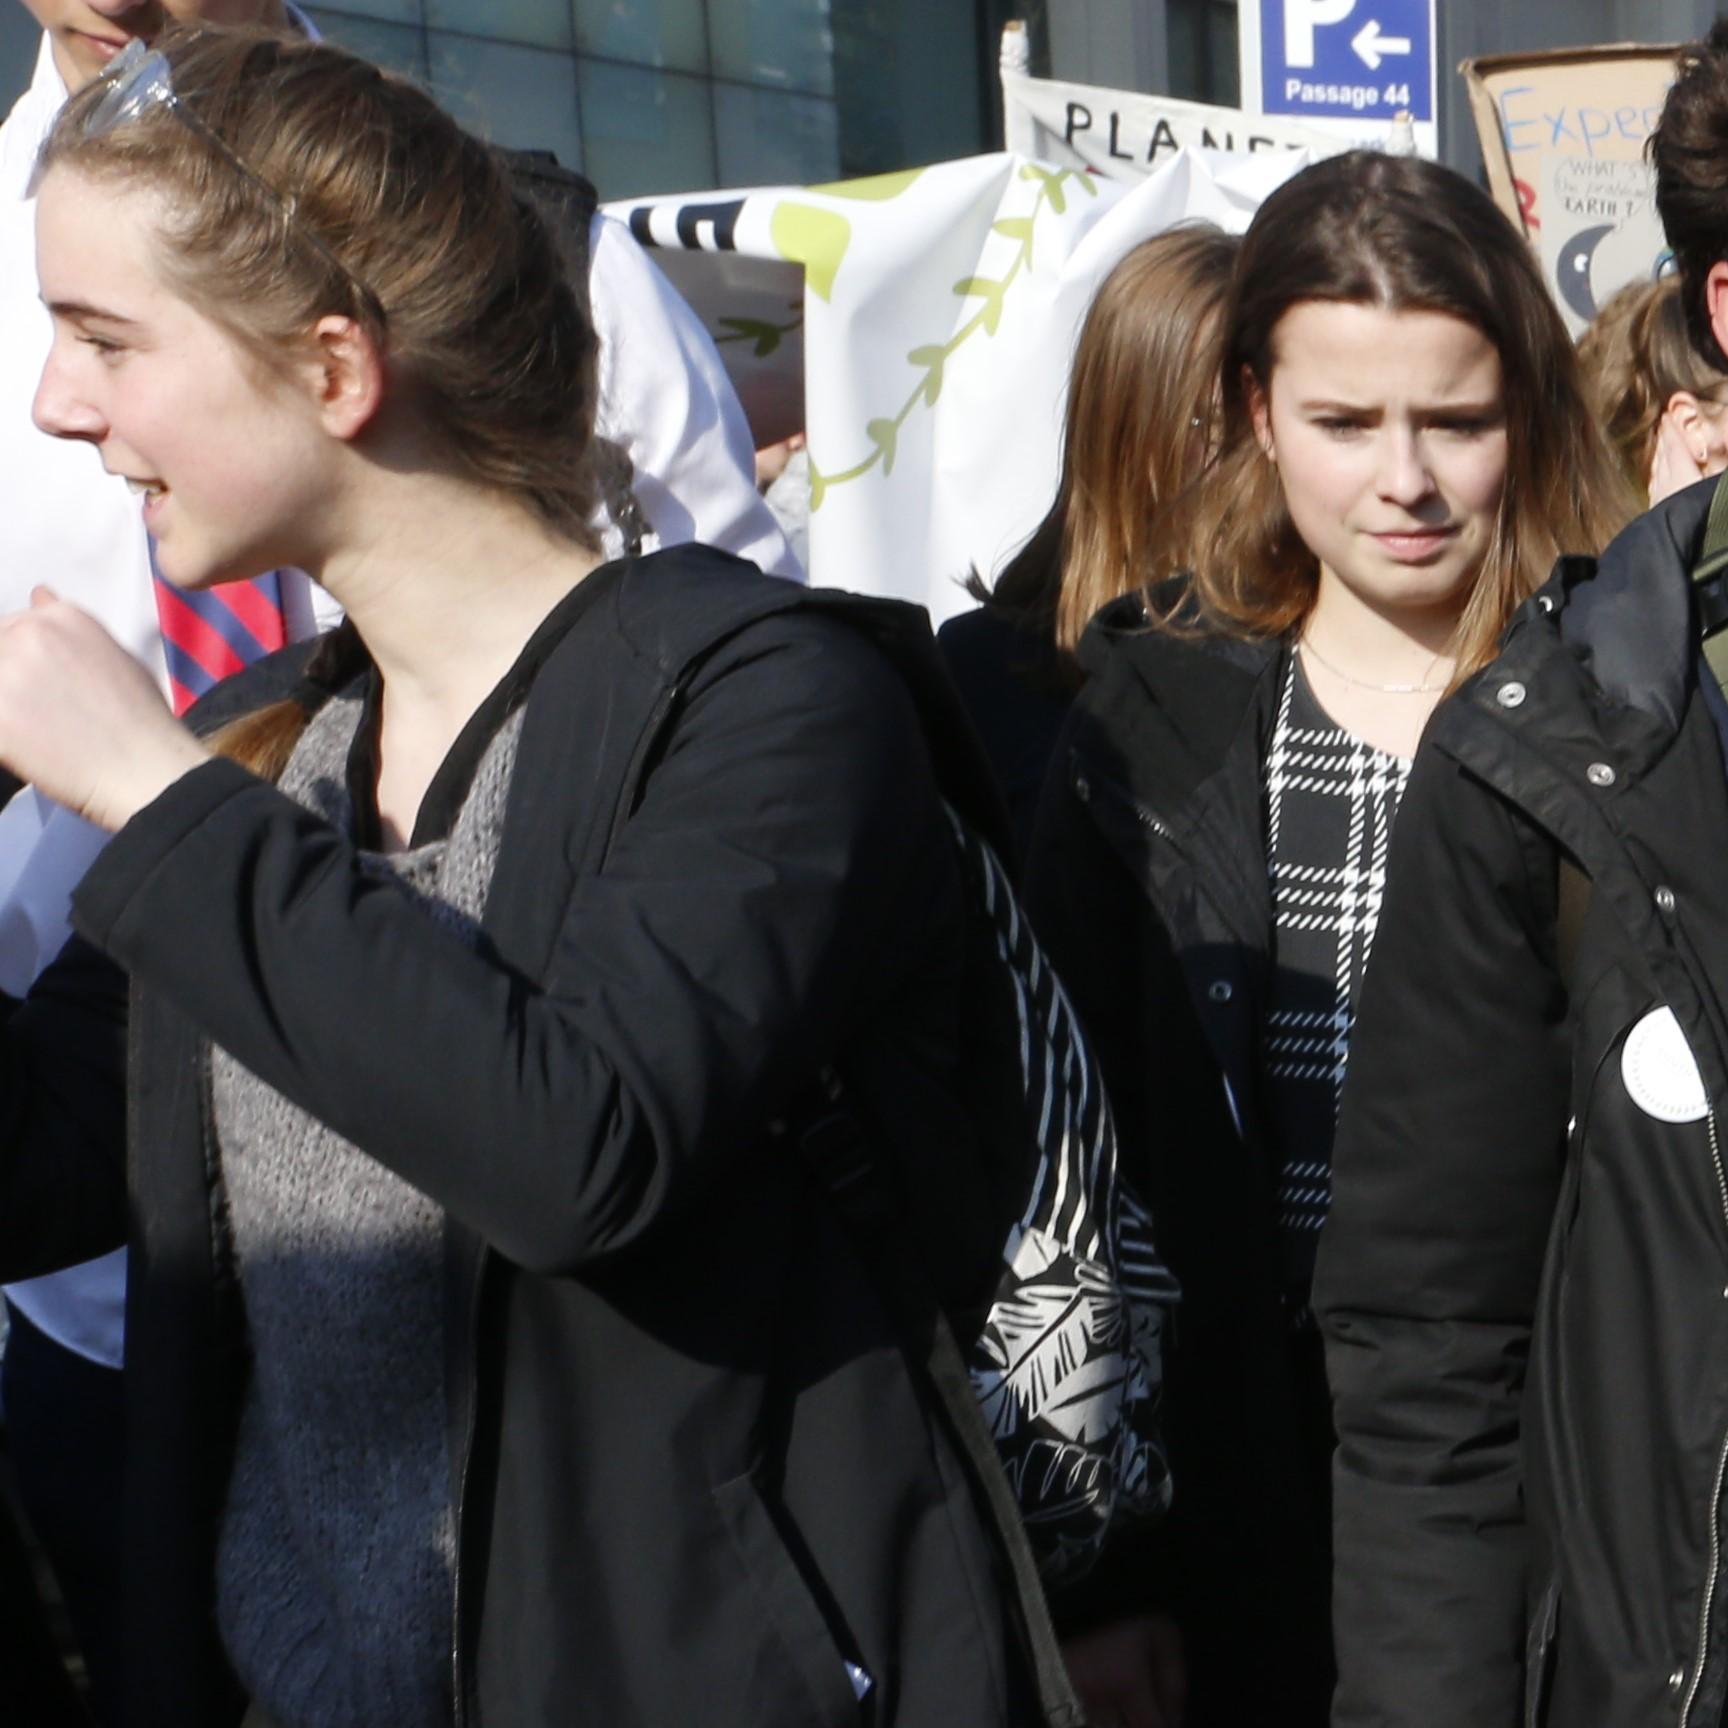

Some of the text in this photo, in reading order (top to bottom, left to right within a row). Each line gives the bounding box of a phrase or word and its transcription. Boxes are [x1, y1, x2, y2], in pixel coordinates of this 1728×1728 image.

[1284, 0, 1357, 68] P
[1285, 79, 1410, 109] Passage 44
[1065, 101, 1305, 164] PLAN
